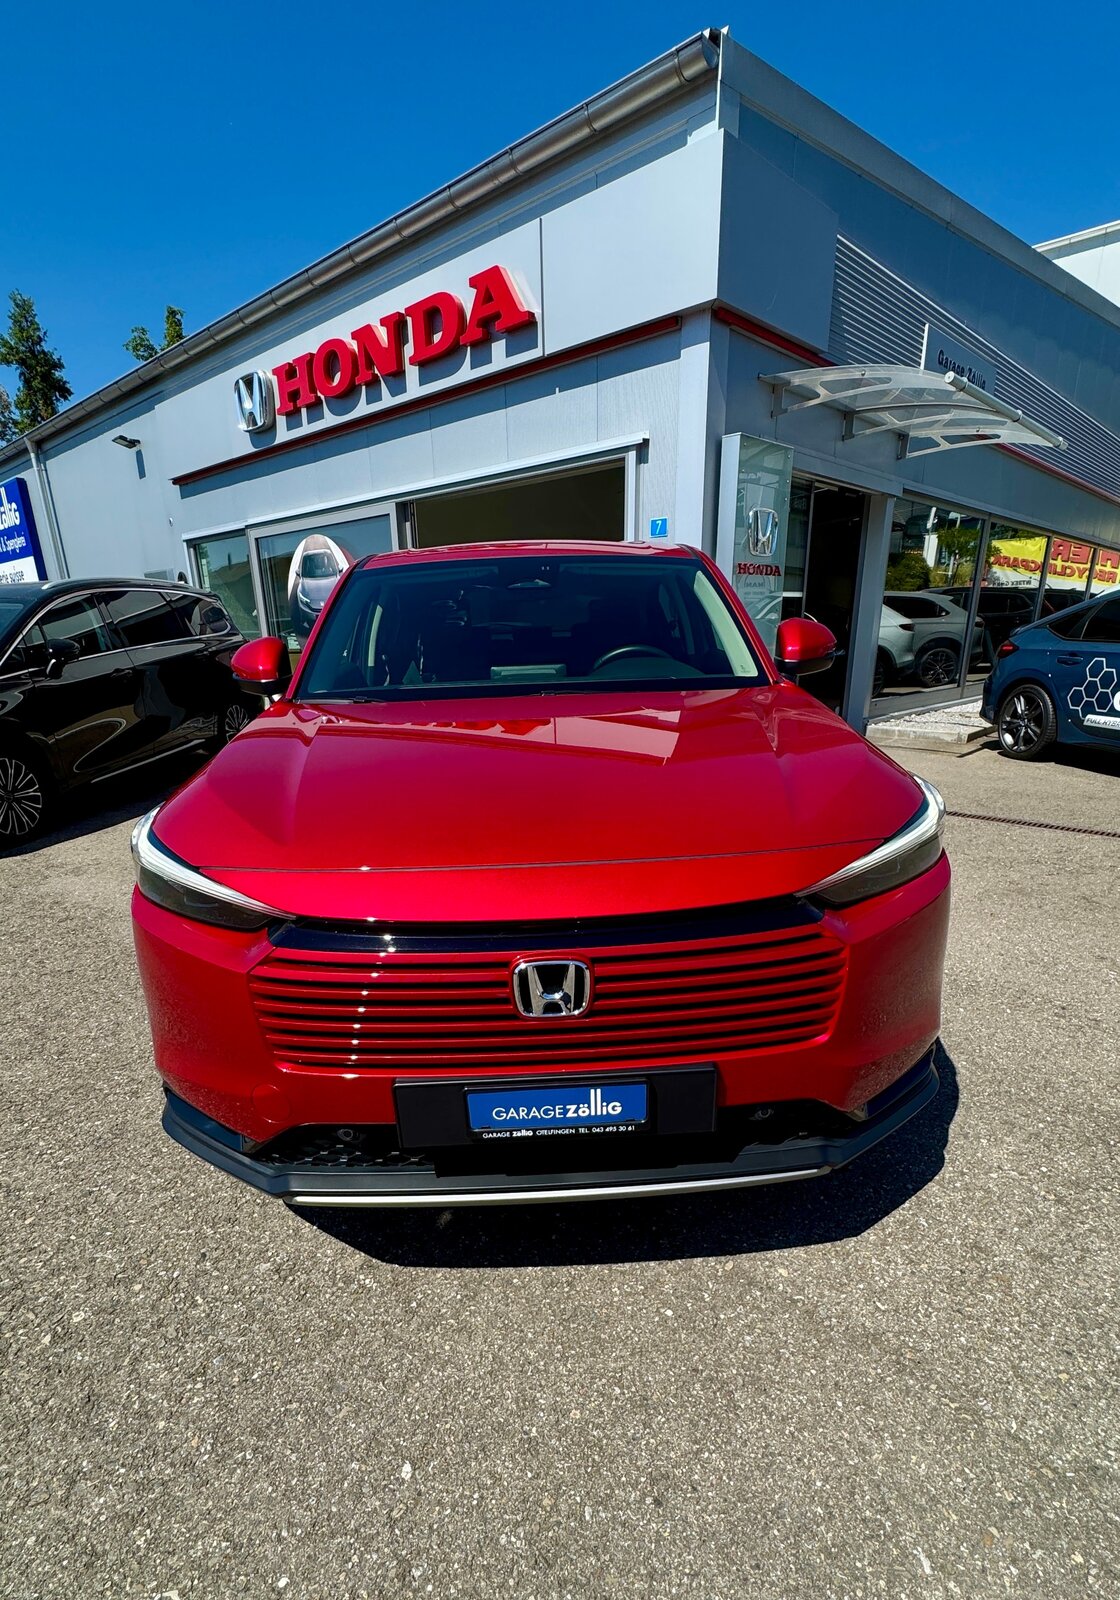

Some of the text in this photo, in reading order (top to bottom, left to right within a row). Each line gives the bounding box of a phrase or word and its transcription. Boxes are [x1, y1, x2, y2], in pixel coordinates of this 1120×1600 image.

[272, 264, 537, 416] HONDA
[656, 520, 662, 535] 7
[737, 562, 782, 577] HONDA
[492, 1105, 564, 1121] GARAGE
[482, 1131, 511, 1139] GARAGE
[536, 1128, 576, 1136] OTELFINGEN
